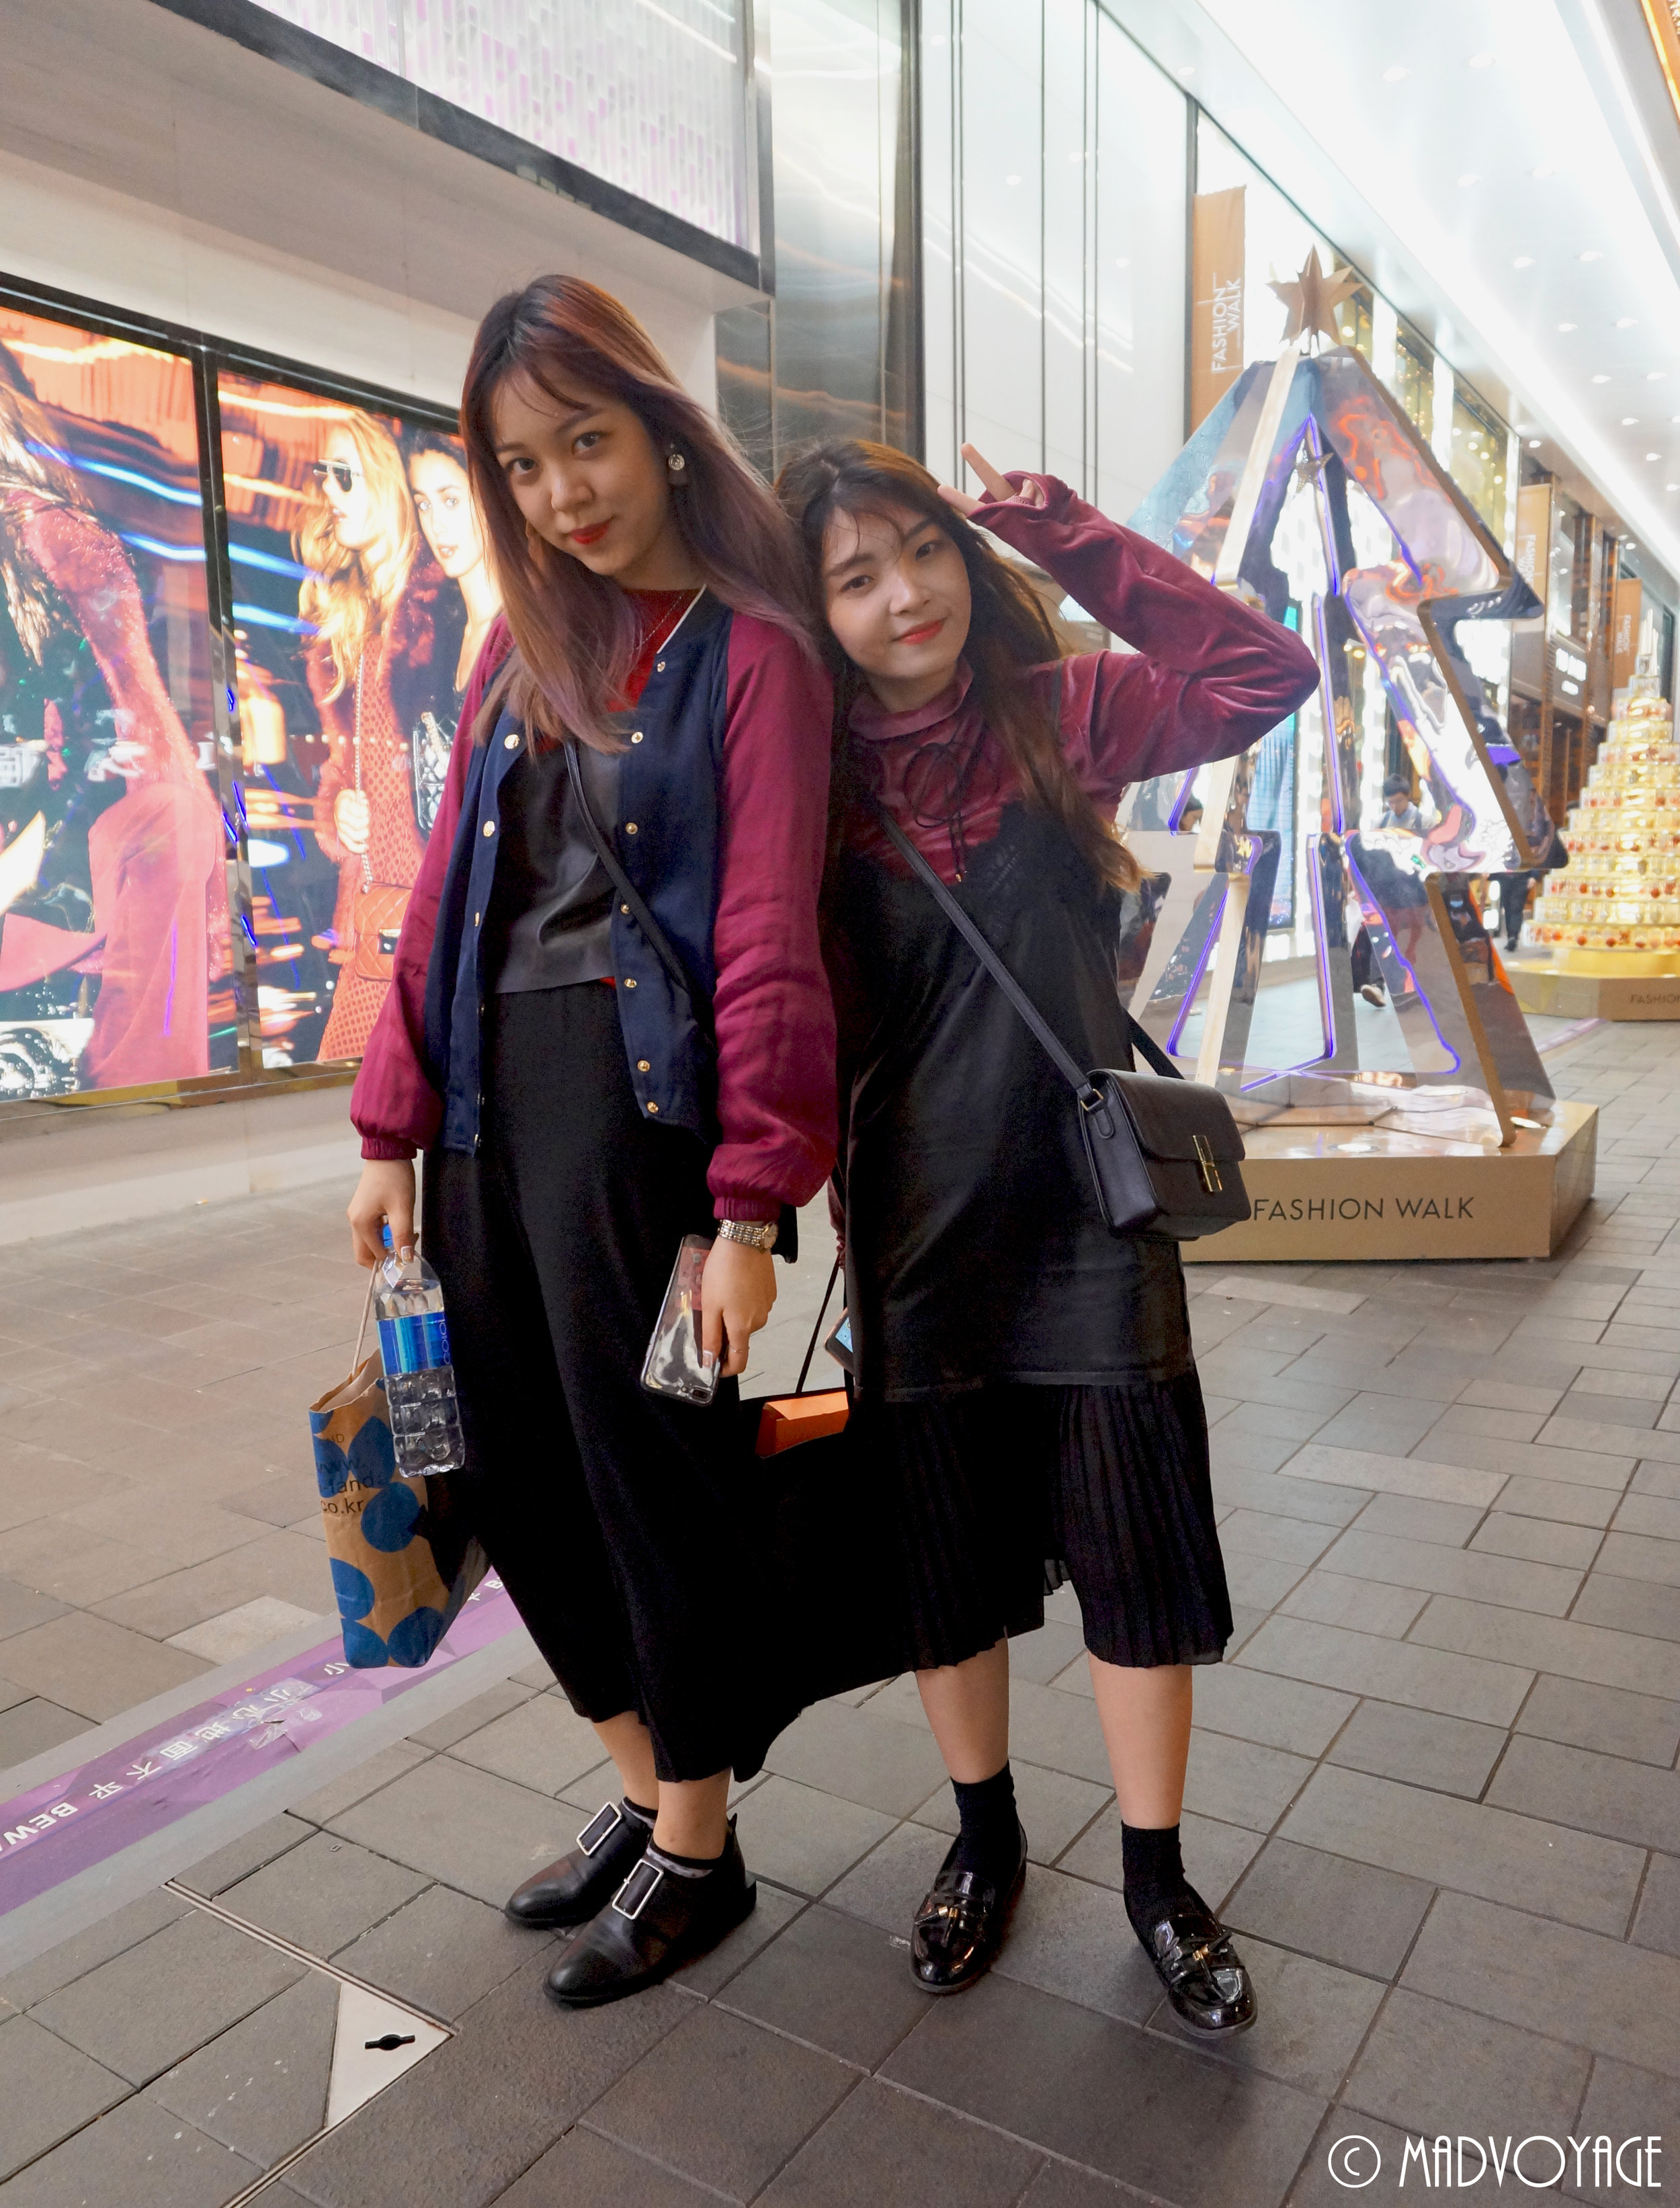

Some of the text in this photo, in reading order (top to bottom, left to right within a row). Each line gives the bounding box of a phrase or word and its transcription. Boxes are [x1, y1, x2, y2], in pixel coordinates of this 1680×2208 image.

[1212, 286, 1227, 372] FASHION
[1226, 278, 1242, 333] WALK
[1254, 1197, 1474, 1220] FASHION WALK
[321, 1498, 364, 1514] co.kr
[0, 1802, 79, 1852] BEW
